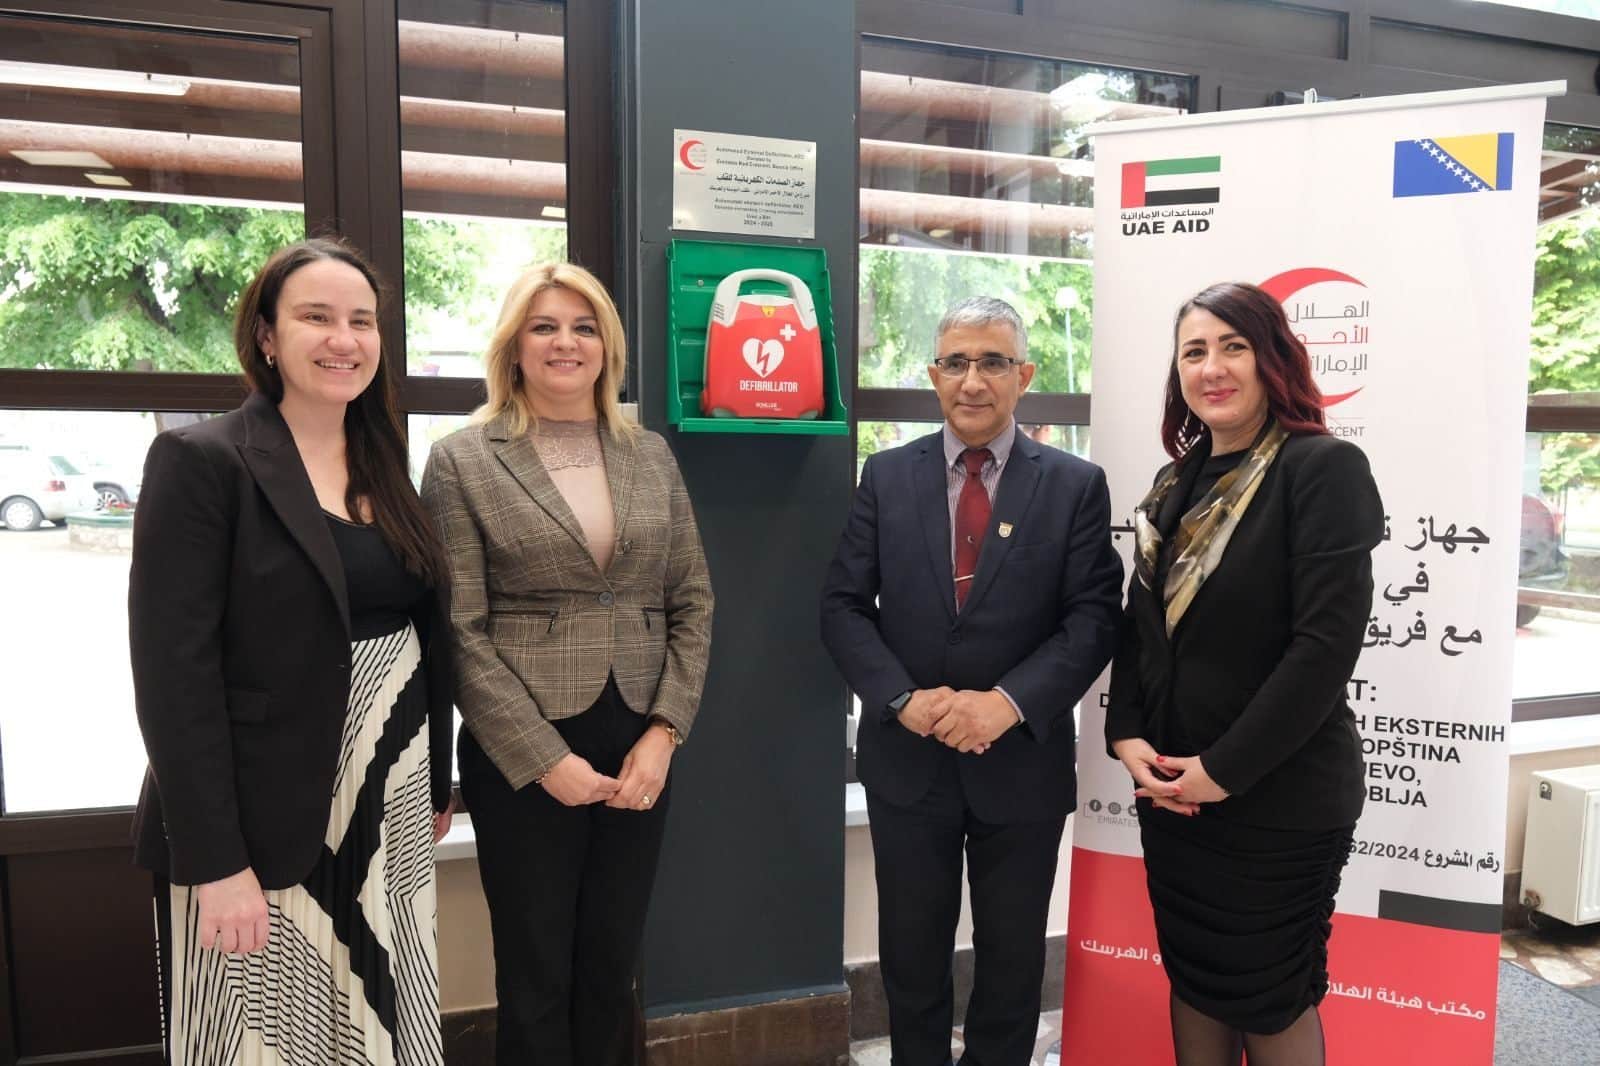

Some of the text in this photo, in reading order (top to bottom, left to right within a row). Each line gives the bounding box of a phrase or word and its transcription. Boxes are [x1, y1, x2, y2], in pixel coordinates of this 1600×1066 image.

[1161, 207, 1215, 218] المساعدات
[1122, 218, 1210, 236] UAE AID
[1287, 299, 1370, 323] الهلال
[1295, 324, 1369, 345] الأحم
[739, 379, 799, 393] DEFIBRILLATOR
[1404, 515, 1490, 554] جهاز
[1383, 561, 1430, 606] في
[1440, 625, 1483, 657] مع
[1346, 678, 1377, 702] T:
[1374, 715, 1505, 742] EKSTERNIH
[1361, 737, 1461, 763] OPŠTINA
[1363, 762, 1421, 786] EVO,
[1423, 849, 1473, 868] المشروع
[1476, 851, 1500, 873] رقم
[1080, 939, 1148, 960] الهرسك
[1376, 986, 1422, 1009] هيئة
[1427, 1000, 1486, 1020] مكتب
